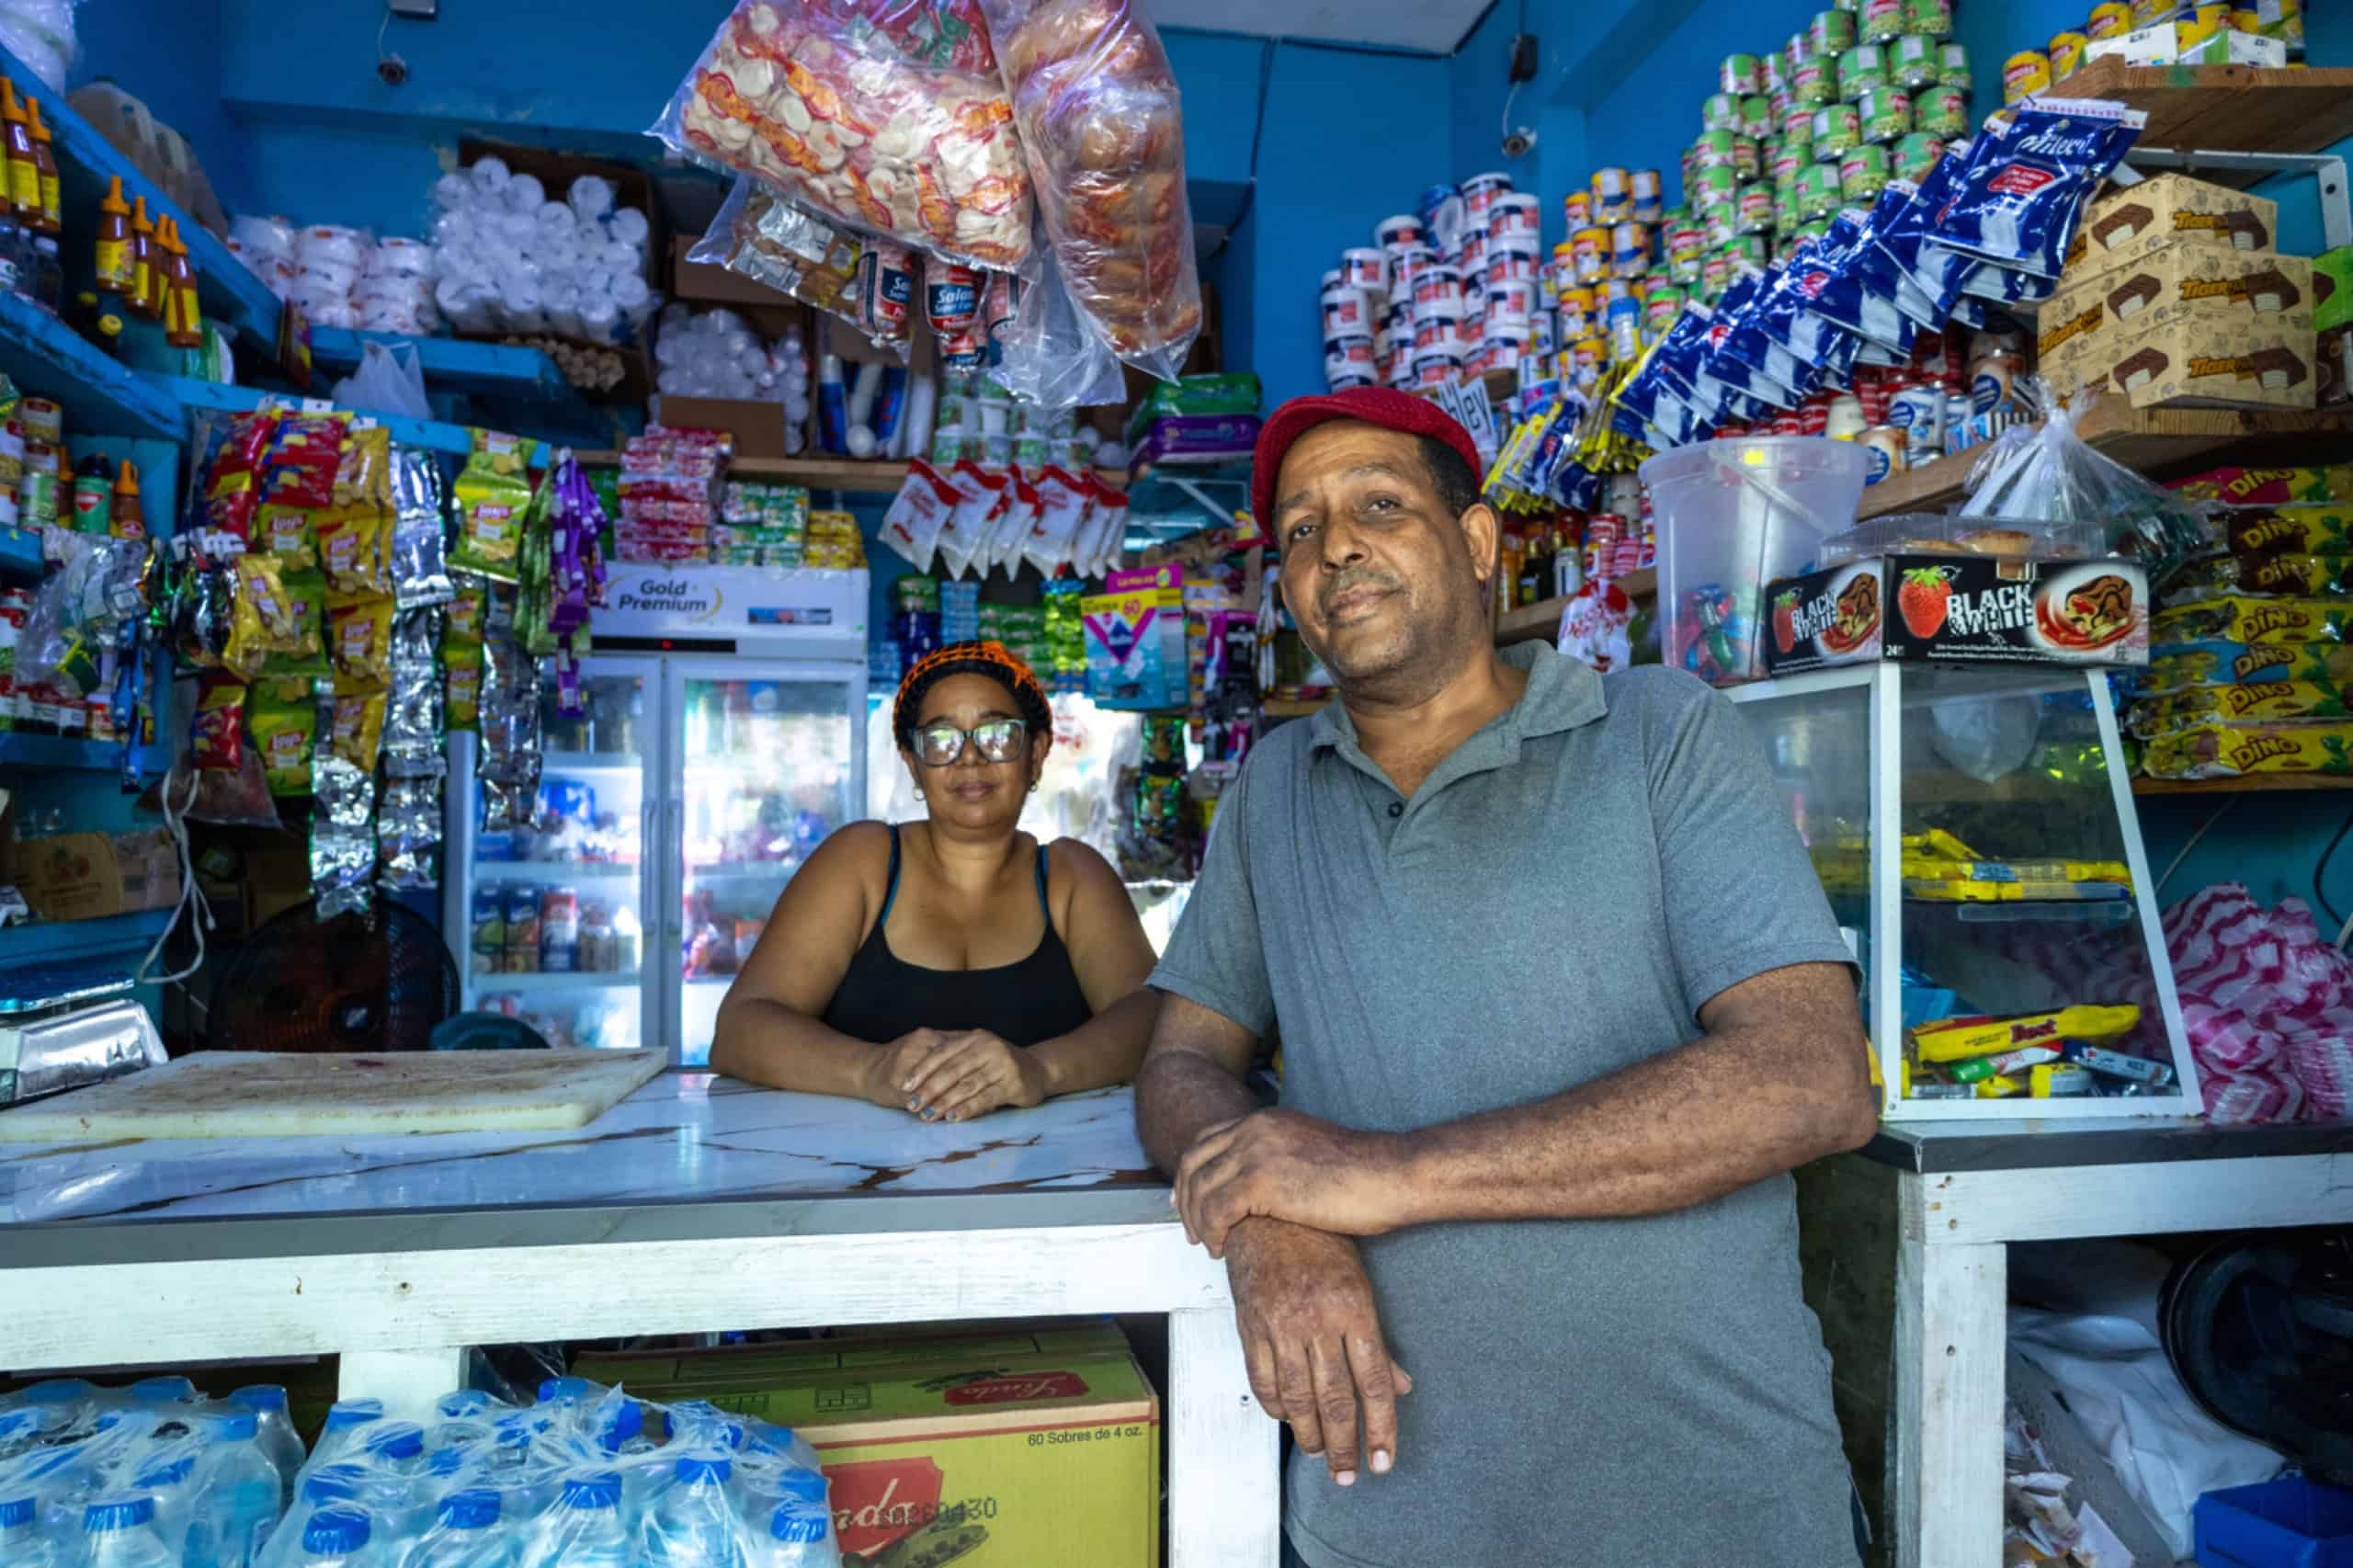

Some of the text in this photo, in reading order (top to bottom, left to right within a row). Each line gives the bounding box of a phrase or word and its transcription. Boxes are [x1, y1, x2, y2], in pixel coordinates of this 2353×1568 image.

[640, 579, 688, 596] Gold
[618, 594, 707, 611] Premium
[1946, 584, 2032, 620] BLACK
[1029, 1426, 1142, 1447] 60 Sobres de 4 oz.
[830, 1477, 914, 1530] nda
